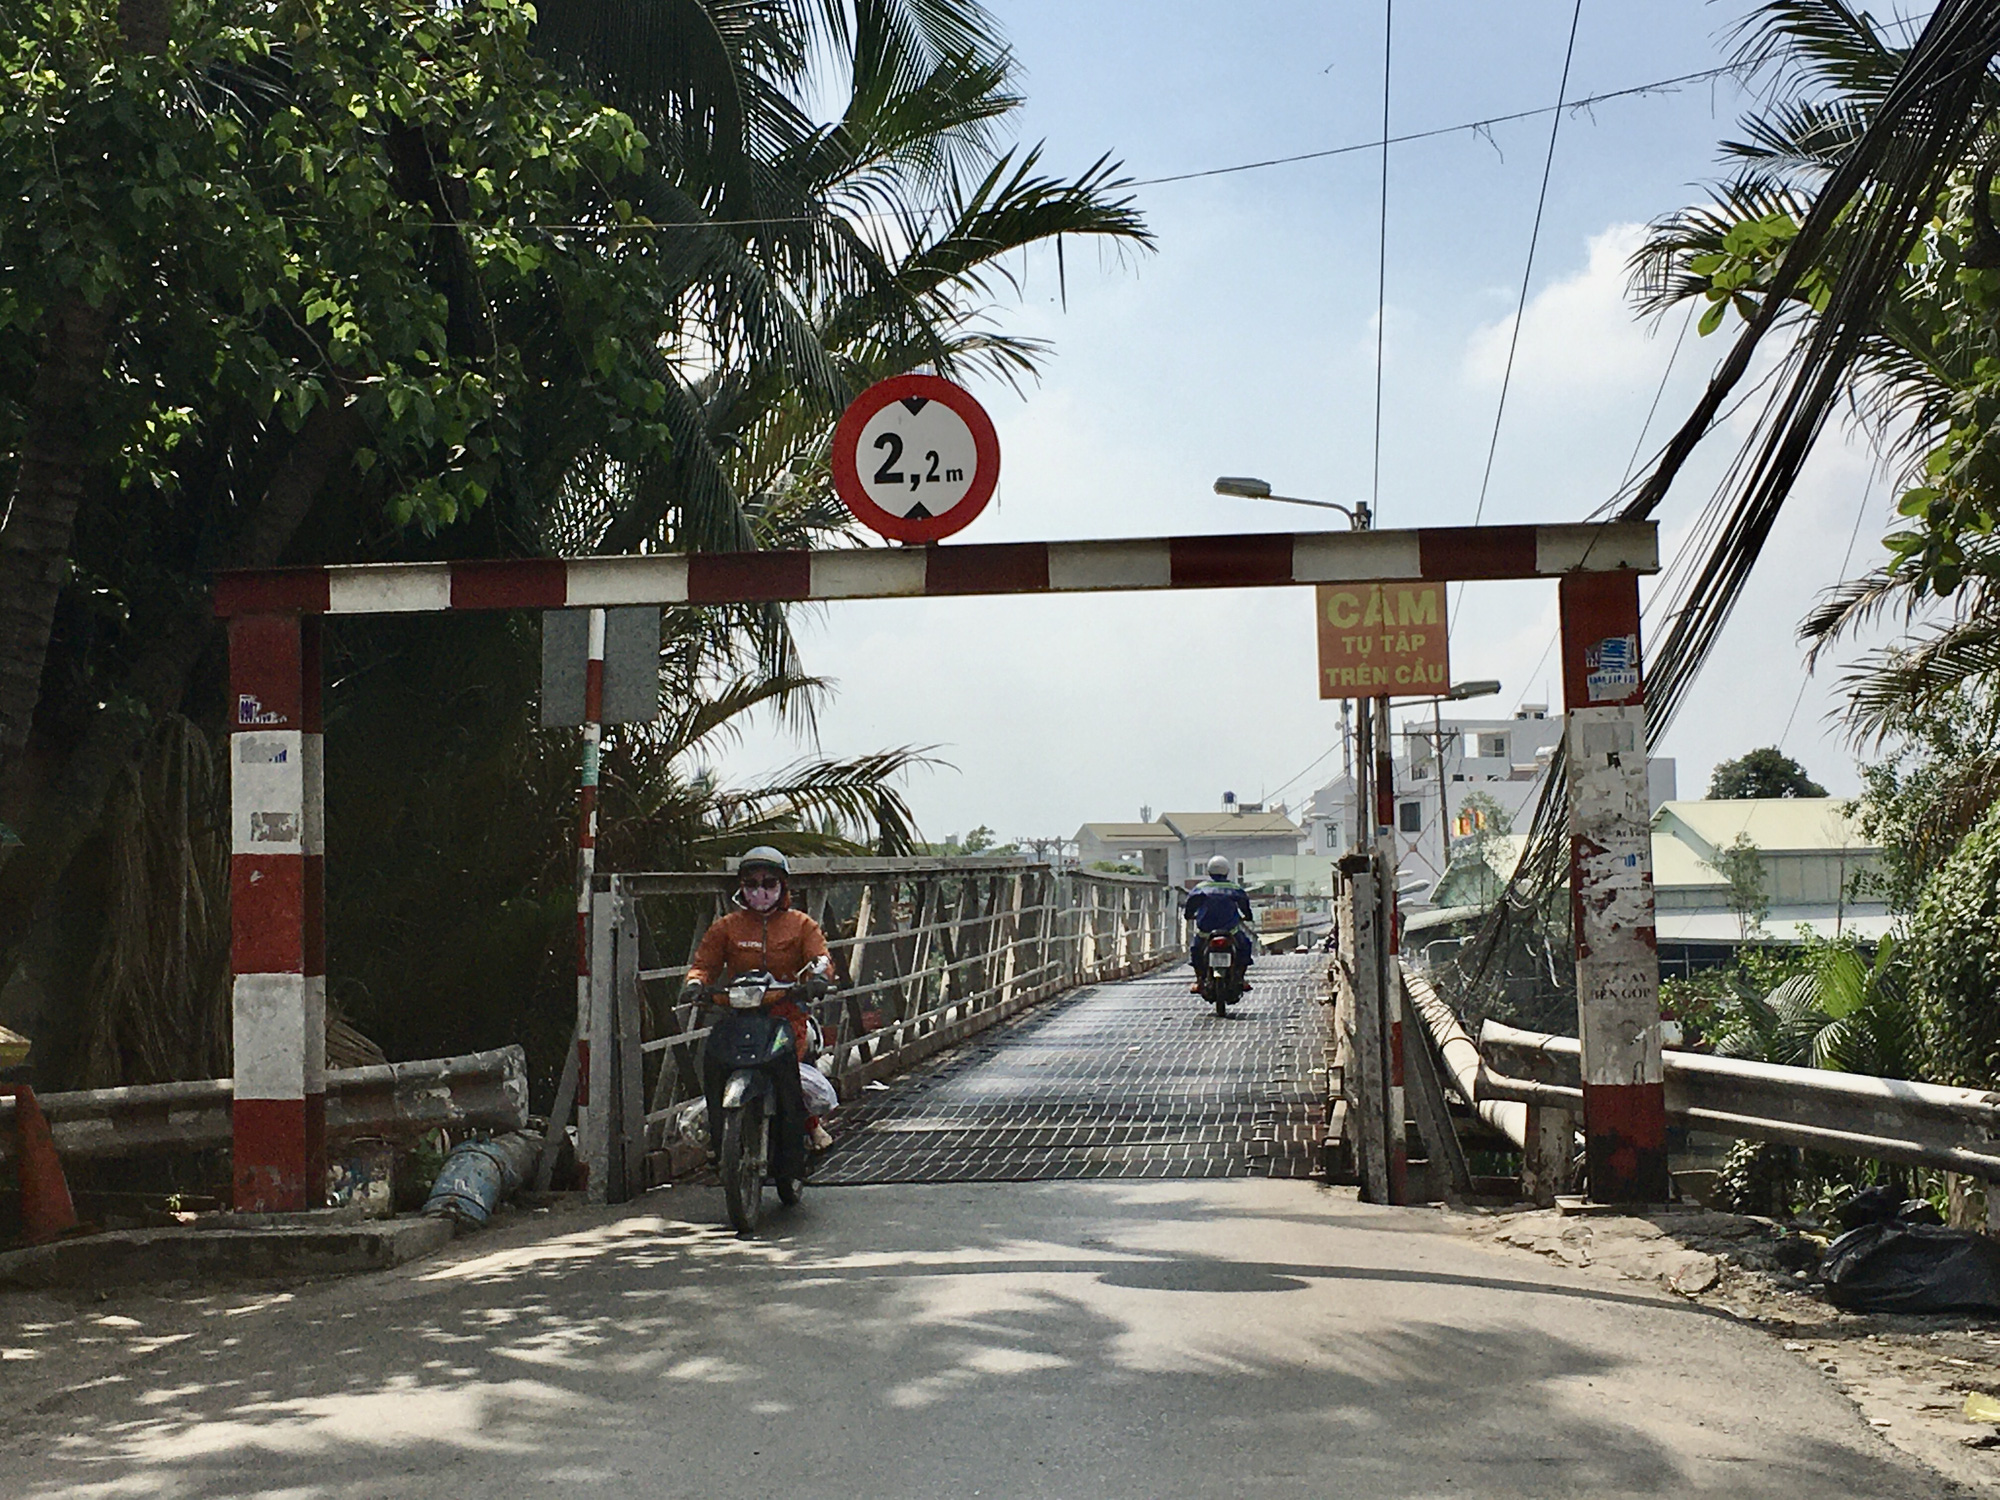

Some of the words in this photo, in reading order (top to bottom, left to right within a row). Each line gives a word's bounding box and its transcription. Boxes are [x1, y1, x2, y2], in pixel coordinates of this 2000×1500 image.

[1341, 635, 1373, 659] TỤ
[1379, 631, 1426, 657] TẬP
[1325, 662, 1389, 687] TRÊN
[1395, 657, 1443, 685] CẦU
